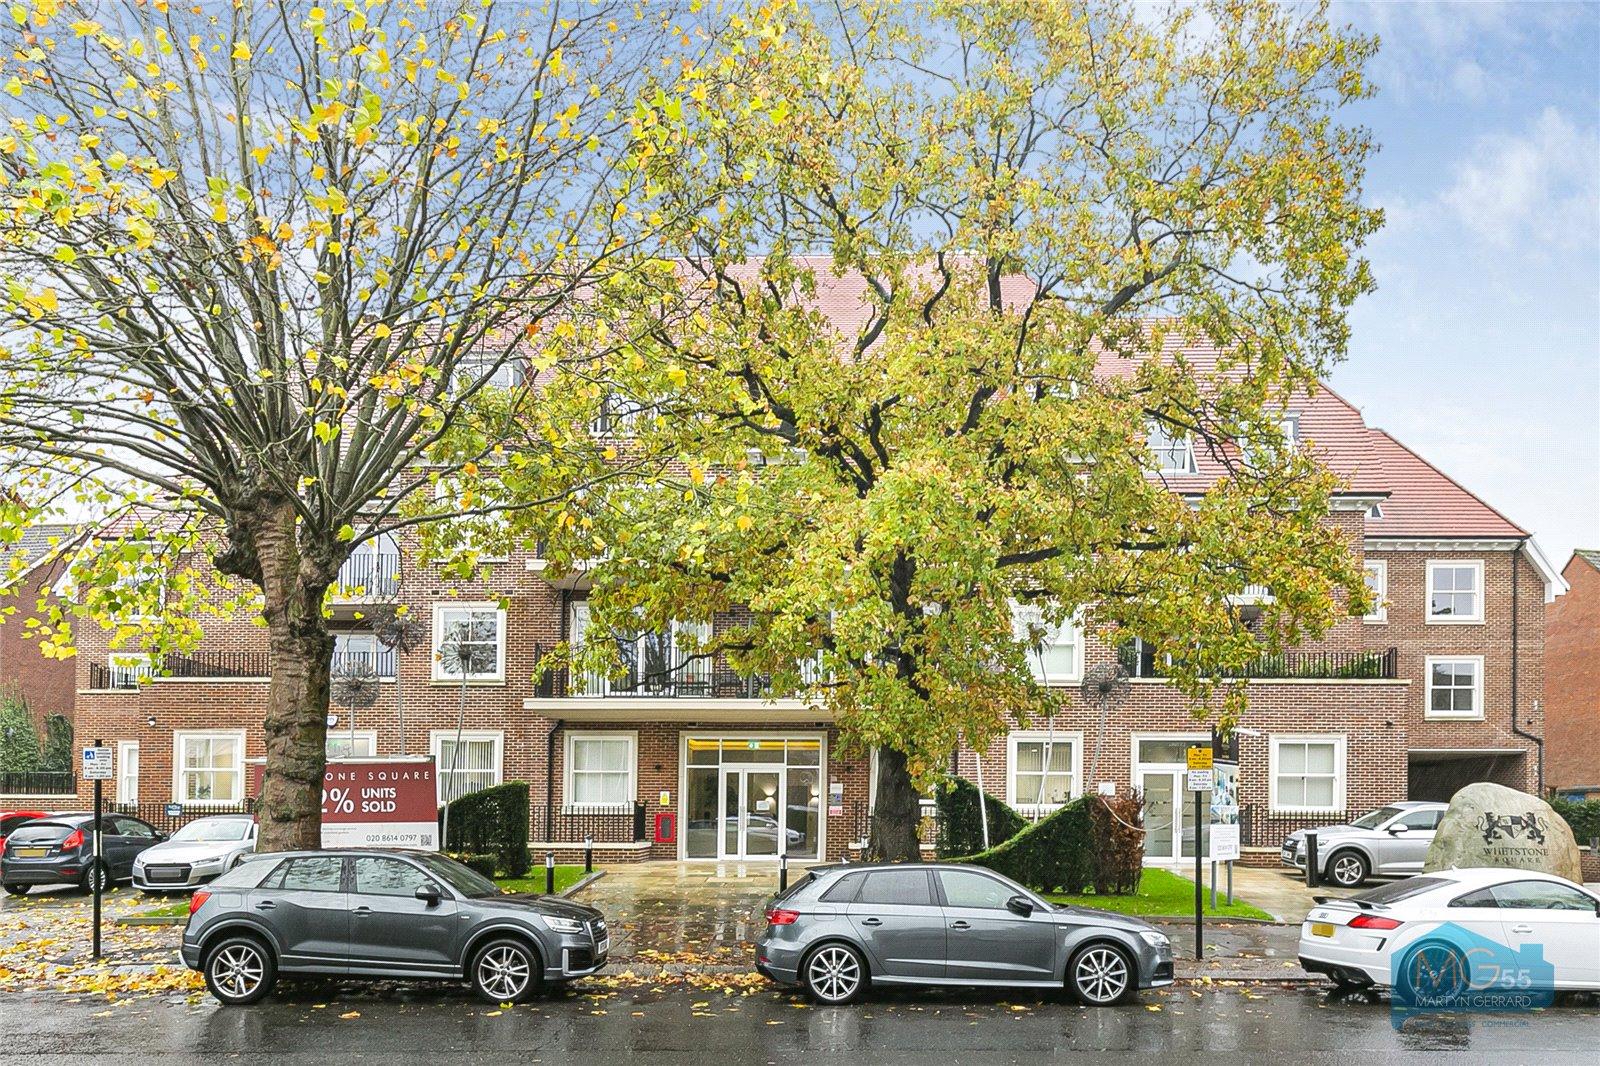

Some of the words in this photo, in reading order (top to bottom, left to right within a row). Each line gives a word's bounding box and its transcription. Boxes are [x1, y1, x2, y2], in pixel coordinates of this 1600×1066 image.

[325, 772, 356, 781] ONE
[368, 771, 430, 781] SQUARE
[361, 787, 397, 799] UNITS
[321, 788, 355, 814] 2%
[361, 801, 396, 813] SOLD
[366, 834, 380, 842] 020
[381, 834, 398, 842] 8614
[400, 834, 417, 842] 0797
[1483, 847, 1549, 858] WHETSTONE
